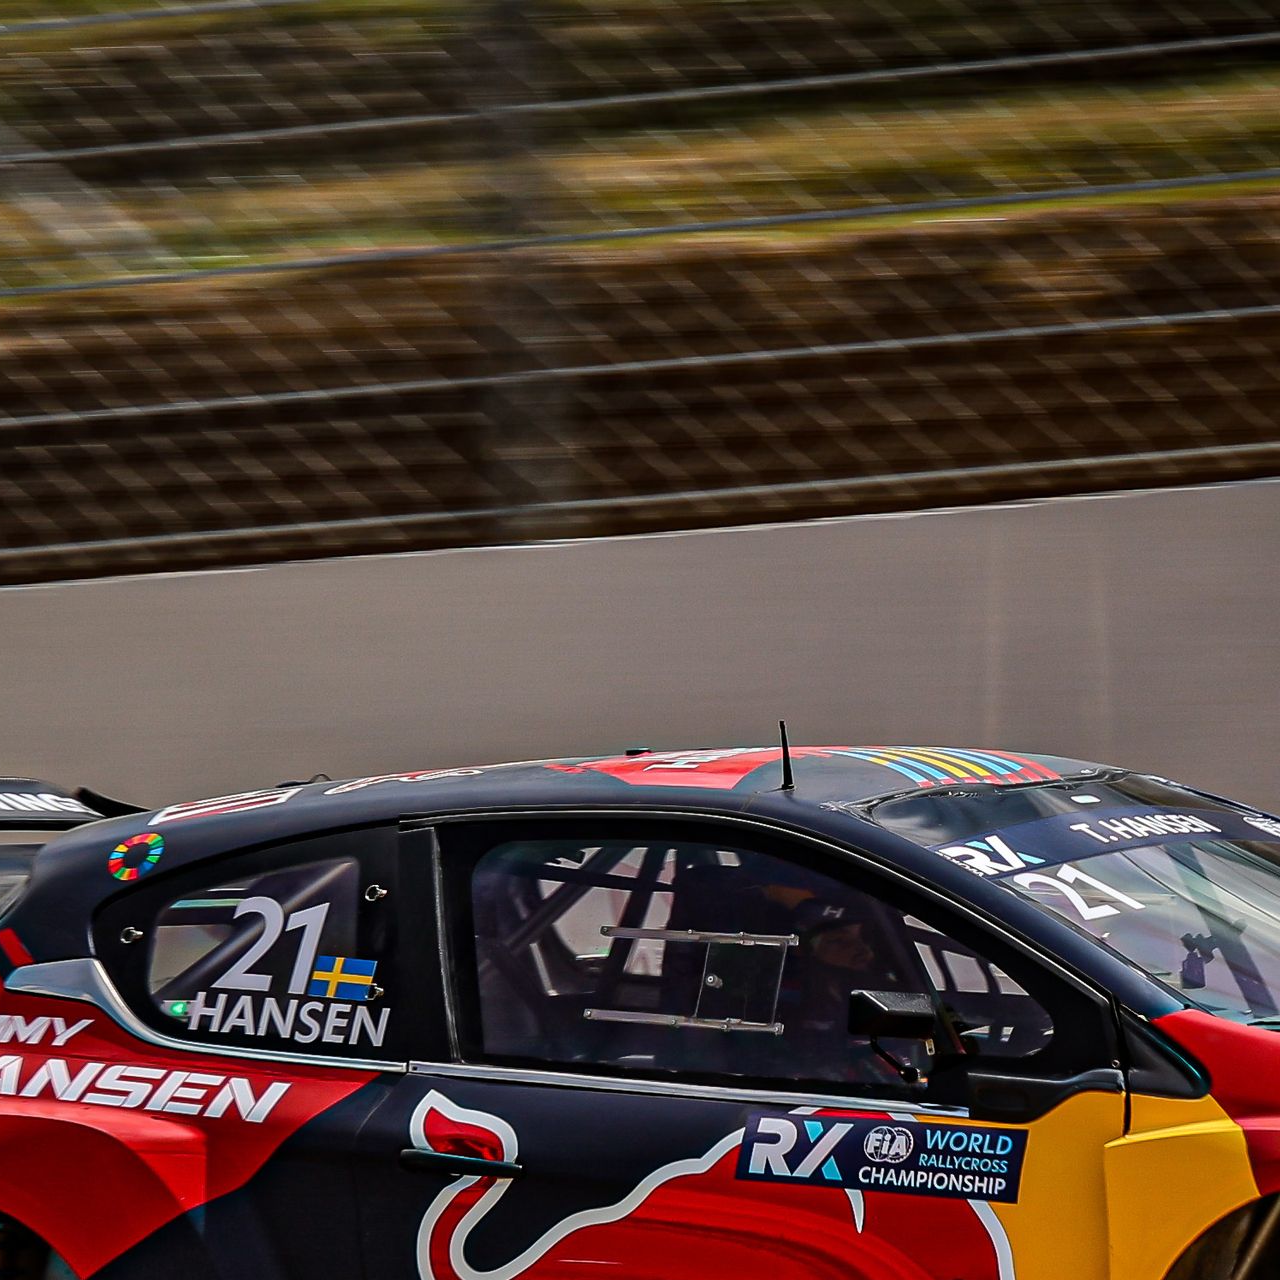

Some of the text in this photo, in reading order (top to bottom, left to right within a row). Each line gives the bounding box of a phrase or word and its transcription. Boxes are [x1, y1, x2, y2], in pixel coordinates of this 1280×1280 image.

[938, 835, 1046, 876] RX
[1013, 863, 1146, 920] 21
[210, 896, 331, 995] 21
[188, 991, 391, 1047] HANSEN
[749, 1117, 855, 1181] RX
[919, 1153, 1009, 1174] RALLYCROSS
[925, 1129, 1013, 1156] WORLD
[858, 1166, 1007, 1195] CHAMPIONSHIP
